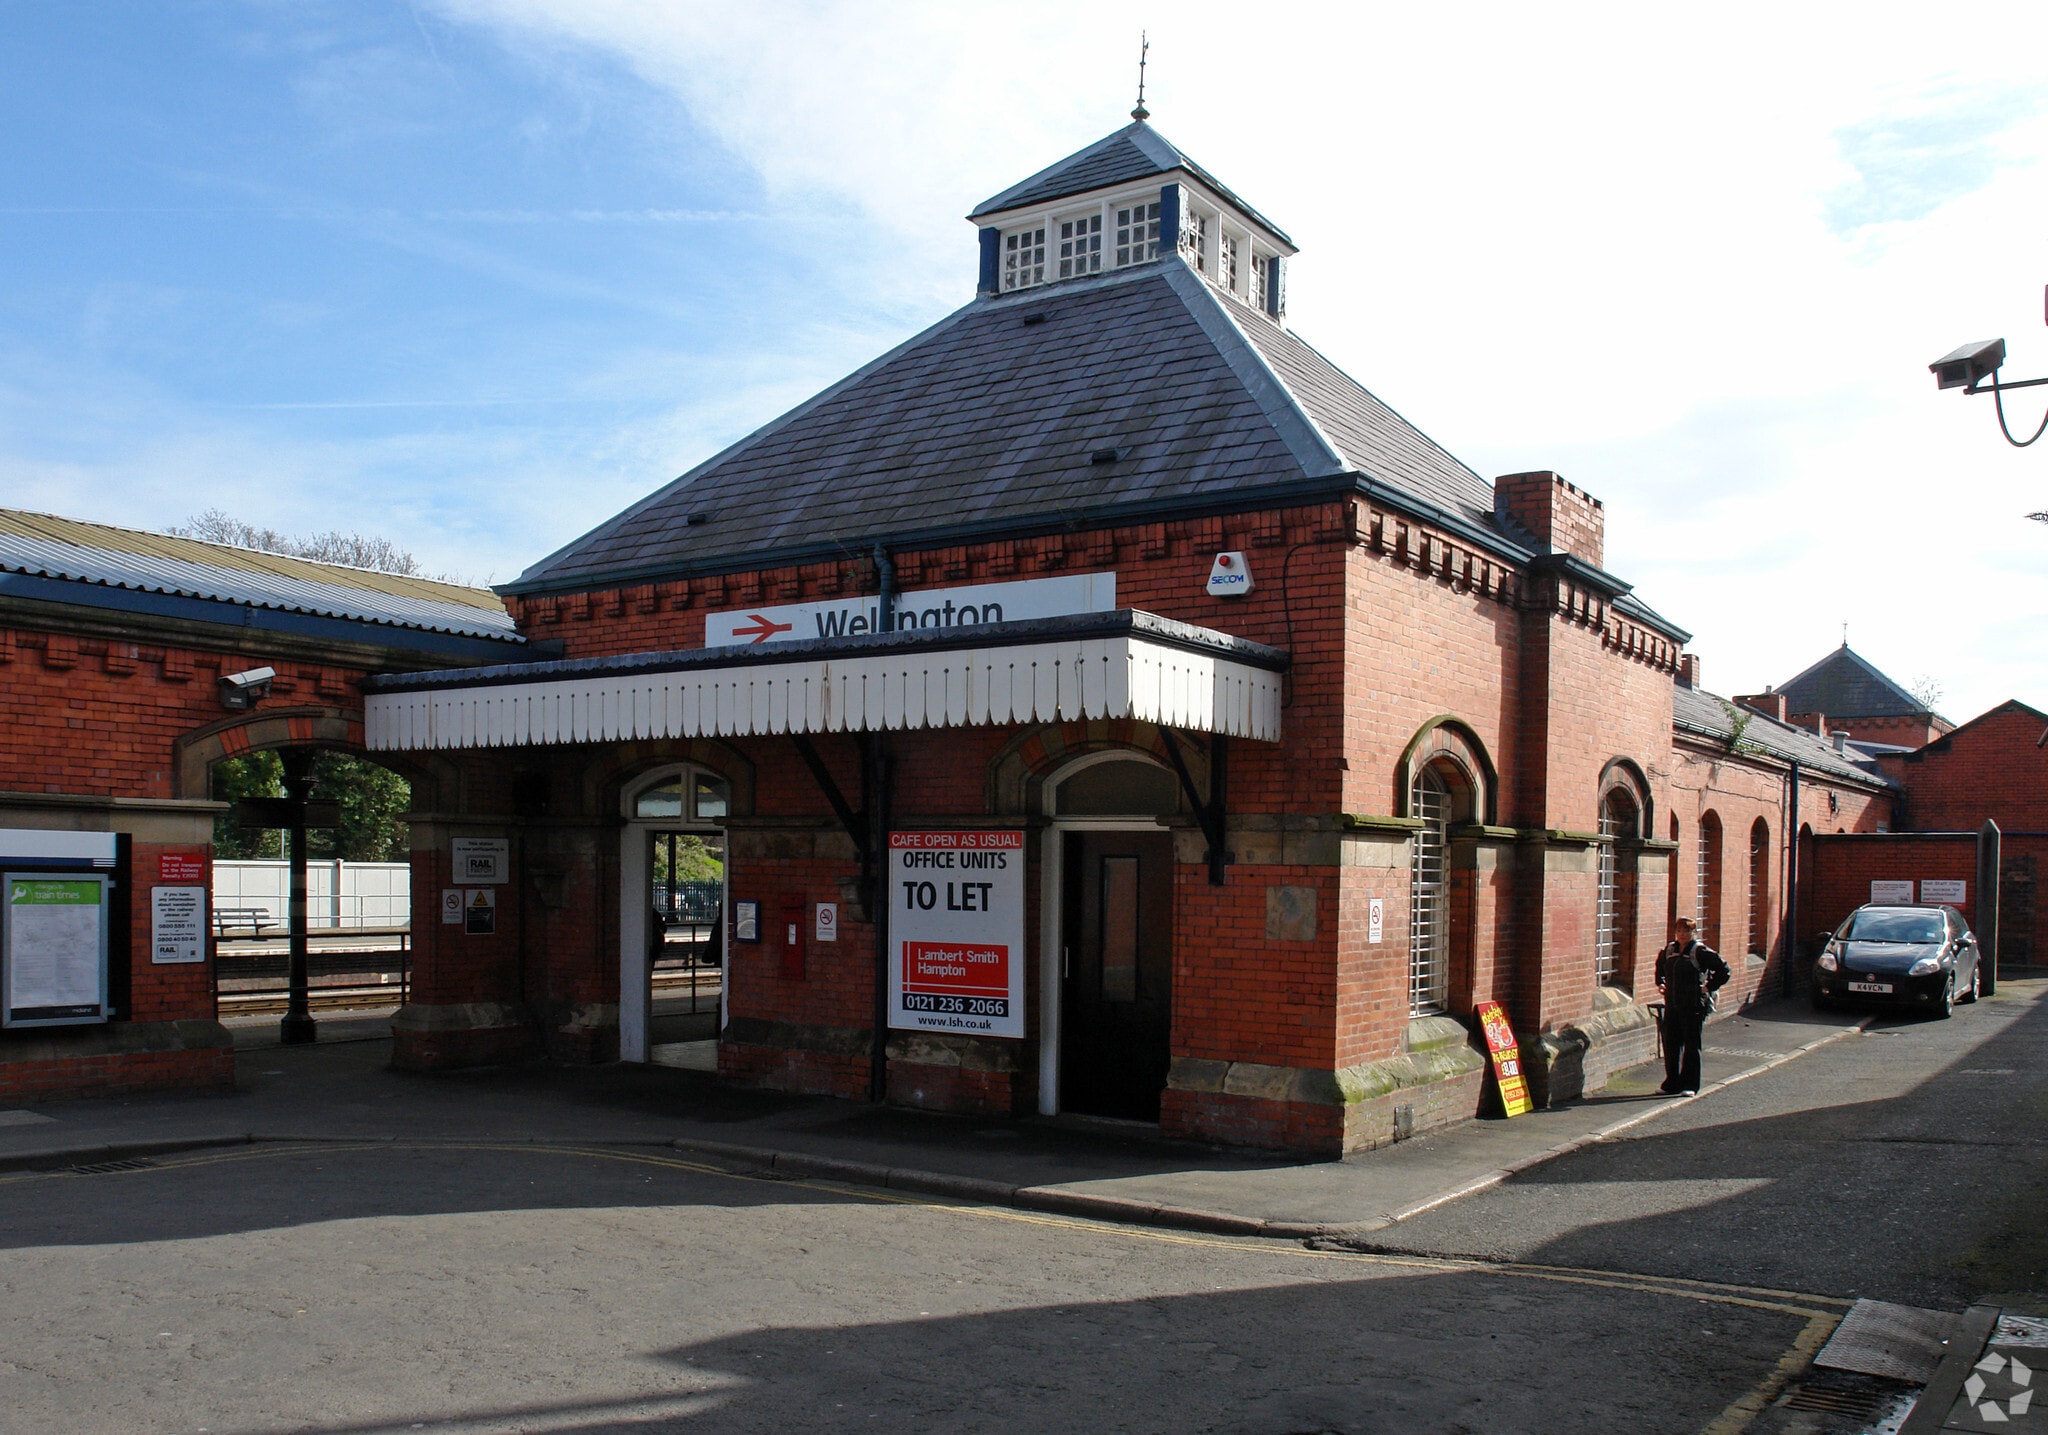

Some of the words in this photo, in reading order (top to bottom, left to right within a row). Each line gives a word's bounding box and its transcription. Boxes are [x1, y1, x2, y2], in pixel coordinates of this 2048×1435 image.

[1211, 574, 1244, 584] SECOM
[891, 834, 922, 846] CAFE
[925, 834, 957, 846] OPEN
[961, 834, 976, 846] AS
[980, 834, 1020, 846] USUAL
[470, 859, 492, 868] RAIL
[903, 851, 954, 868] OFFICE
[960, 852, 1007, 869] UNITS
[35, 890, 56, 899] train
[56, 890, 80, 899] times
[903, 881, 936, 910] TO
[947, 882, 993, 911] LET
[918, 948, 963, 962] Lambert
[966, 950, 999, 964] Smith
[918, 962, 966, 977] Hampton
[906, 995, 935, 1010] 0121
[939, 998, 964, 1012] 236
[968, 1000, 1004, 1015] 2066
[918, 1017, 992, 1029] www.lsh.co.uk
